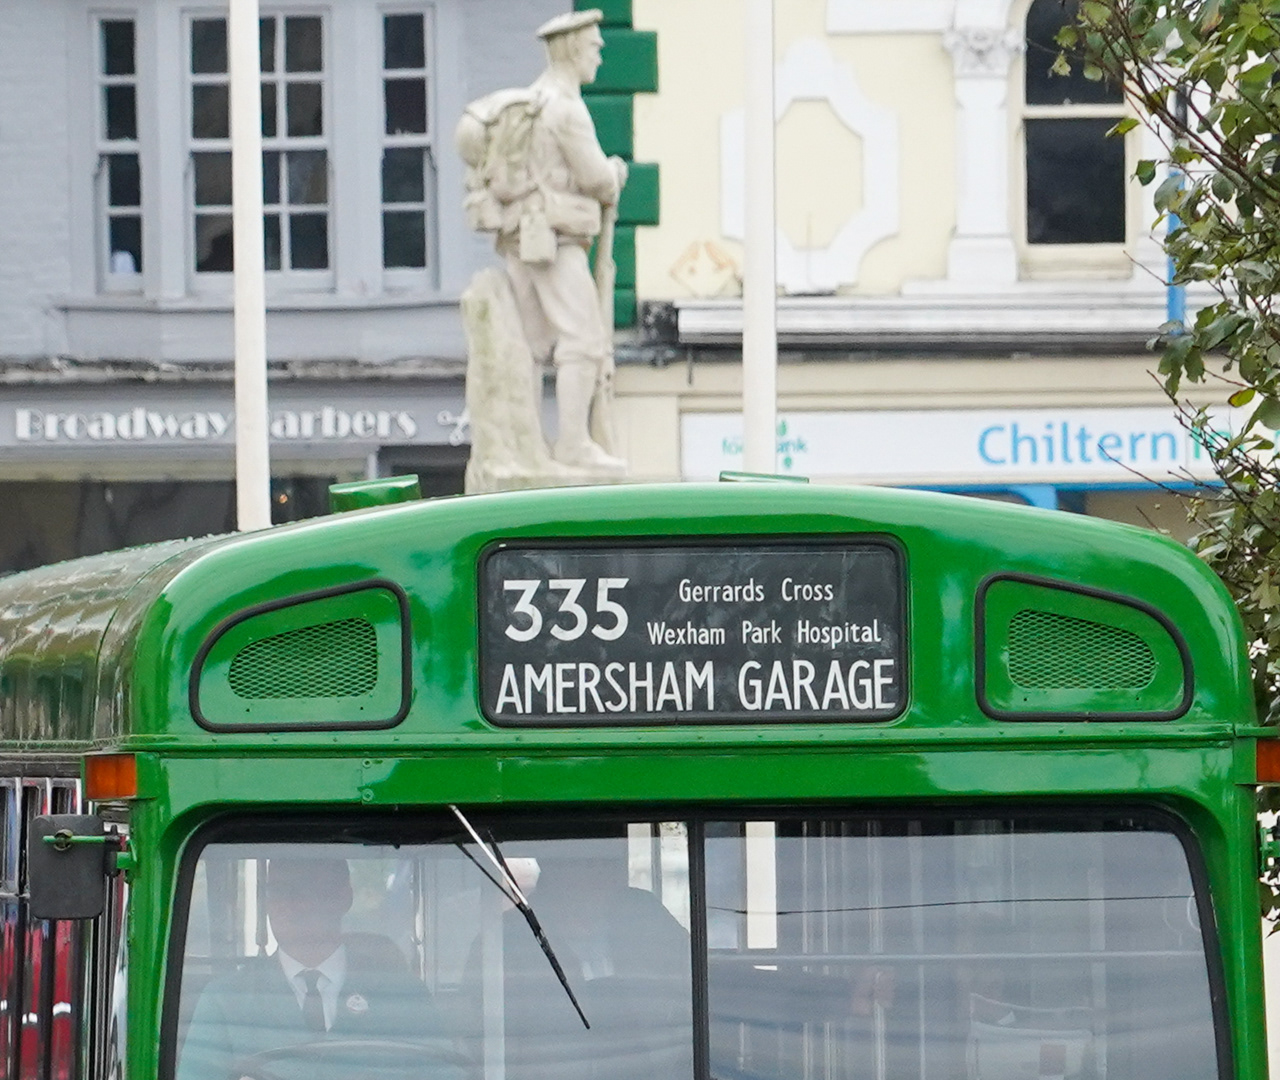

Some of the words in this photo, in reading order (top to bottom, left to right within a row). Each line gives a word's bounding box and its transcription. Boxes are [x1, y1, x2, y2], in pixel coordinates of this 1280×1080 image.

[15, 407, 233, 441] Broadway
[270, 405, 418, 440] arbers
[978, 422, 1177, 465] Chiltern
[504, 578, 629, 641] 335
[678, 577, 765, 603] Gerrards
[781, 577, 834, 602] Cross
[646, 620, 725, 646] Wexham
[742, 619, 782, 644] Park
[797, 618, 882, 650] Hospital
[496, 660, 715, 714] AMERSHAM
[738, 658, 896, 711] GARAGE
